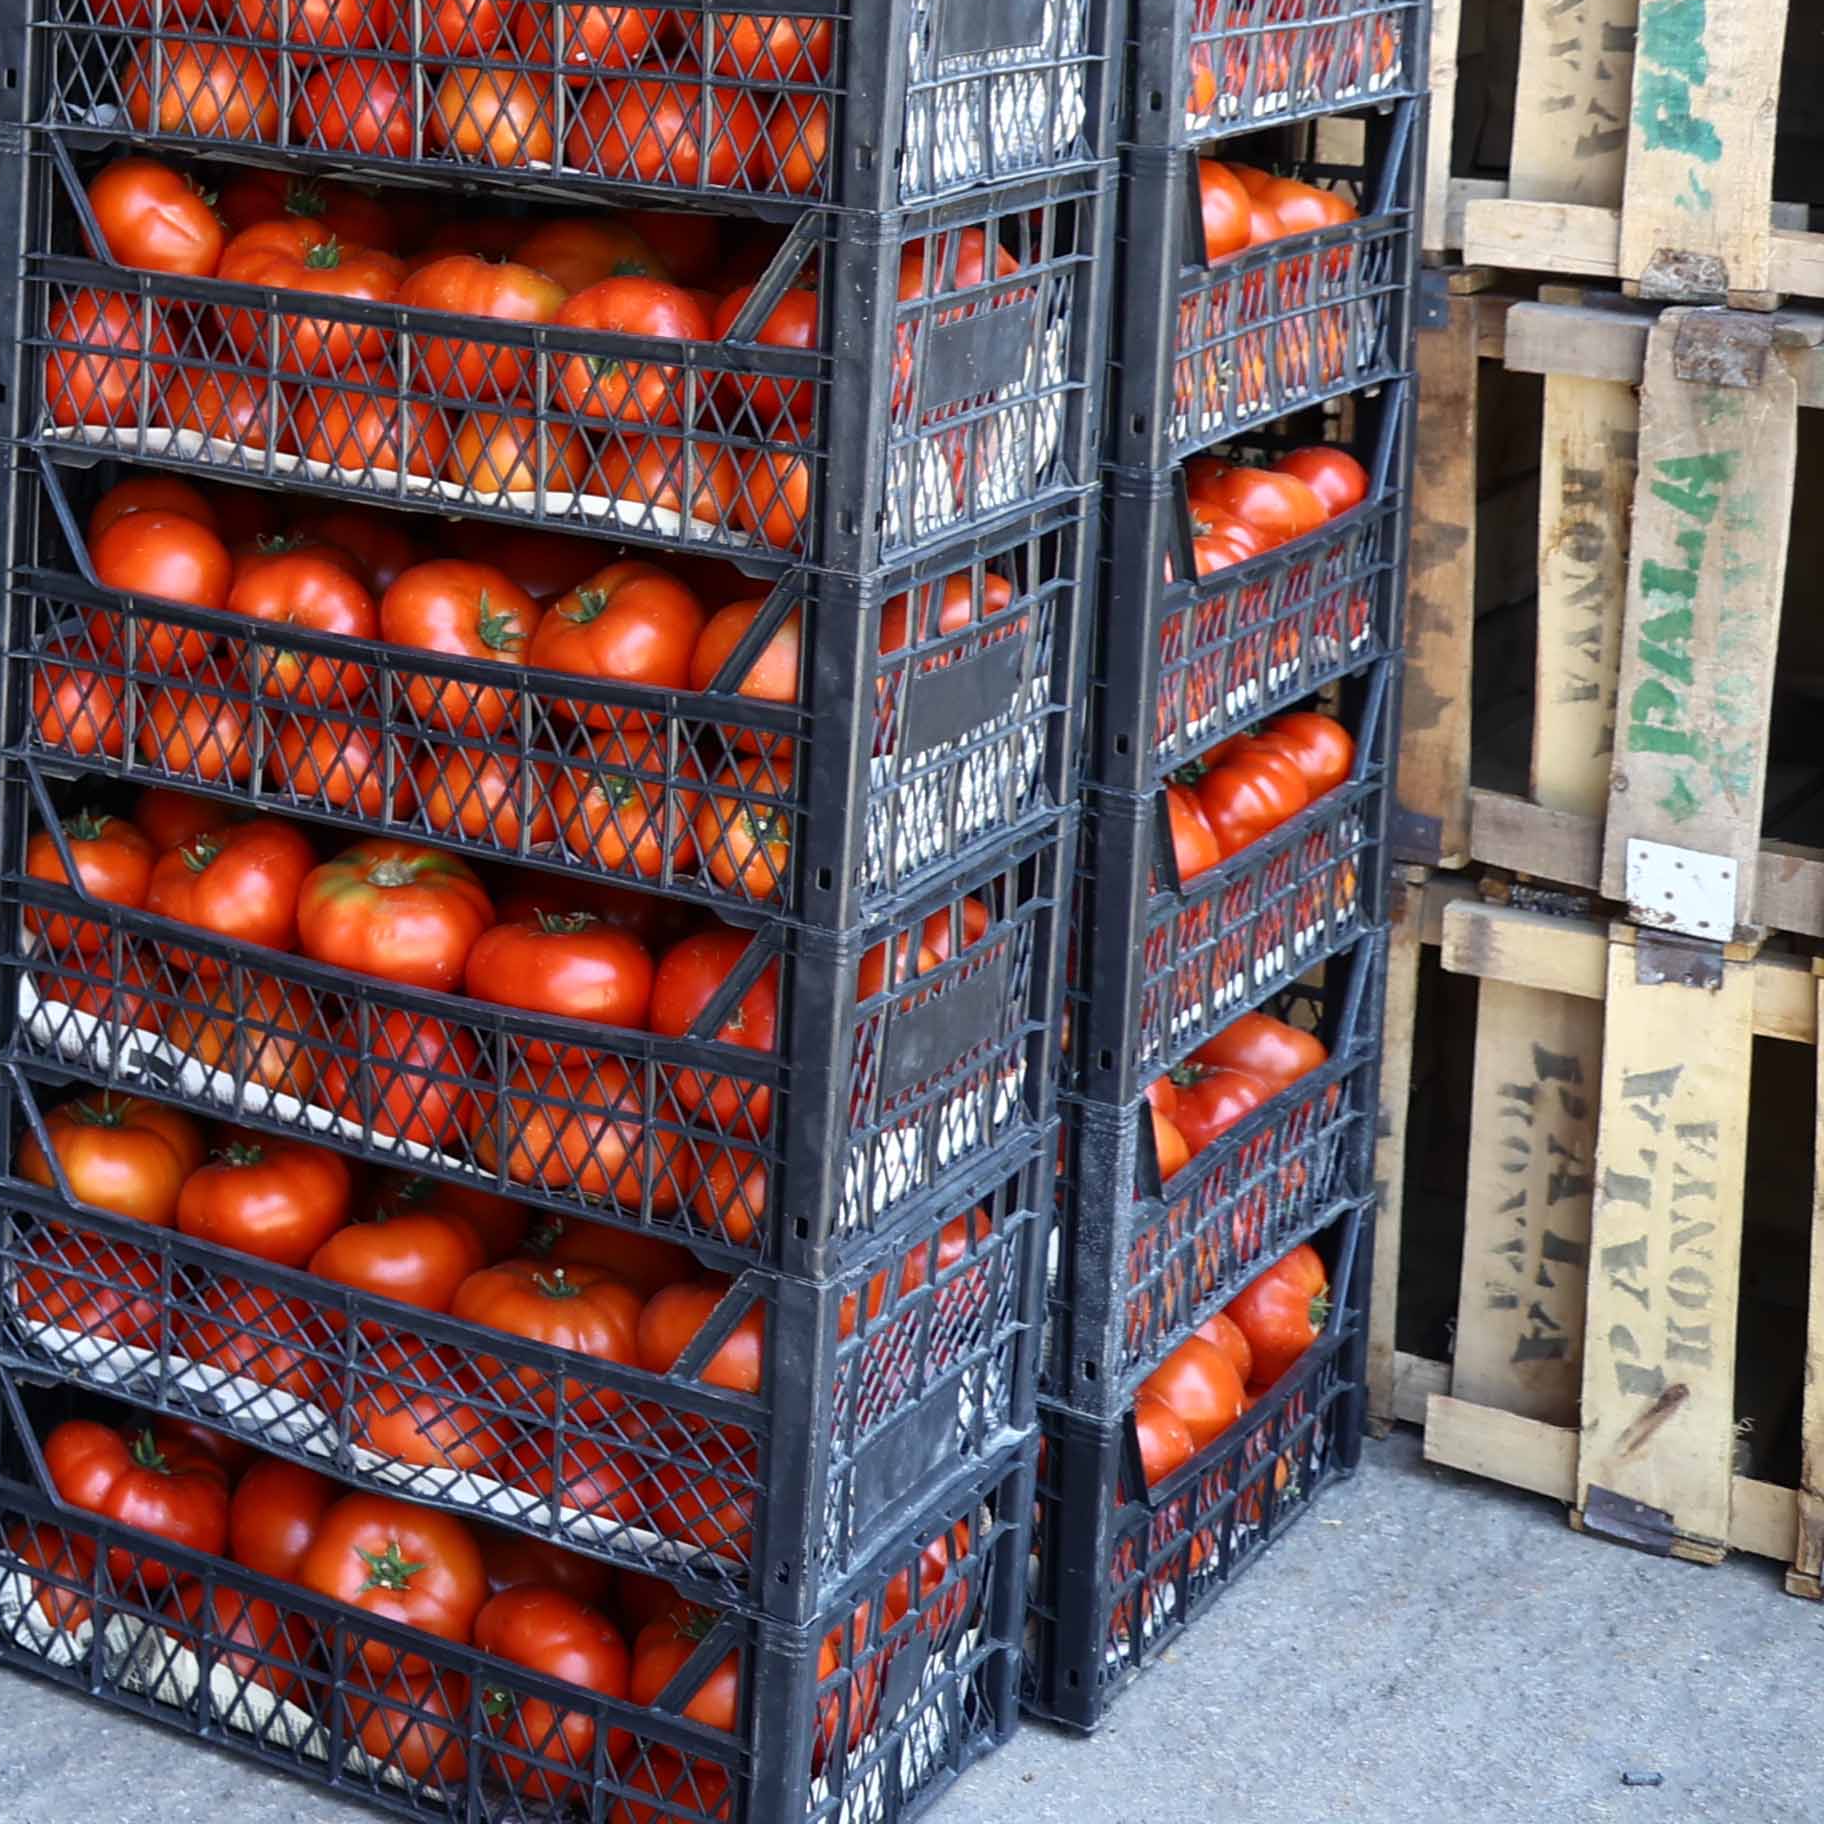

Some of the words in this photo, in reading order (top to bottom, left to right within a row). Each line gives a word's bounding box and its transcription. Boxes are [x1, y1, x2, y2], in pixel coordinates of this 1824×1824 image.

[1553, 465, 1611, 704] KONYA
[1626, 449, 1742, 761] PALA
[1485, 1082, 1544, 1310] KONYA
[1510, 1040, 1593, 1364] PALA
[1599, 1064, 1684, 1399] PALA
[1664, 1119, 1718, 1371] KONYA
